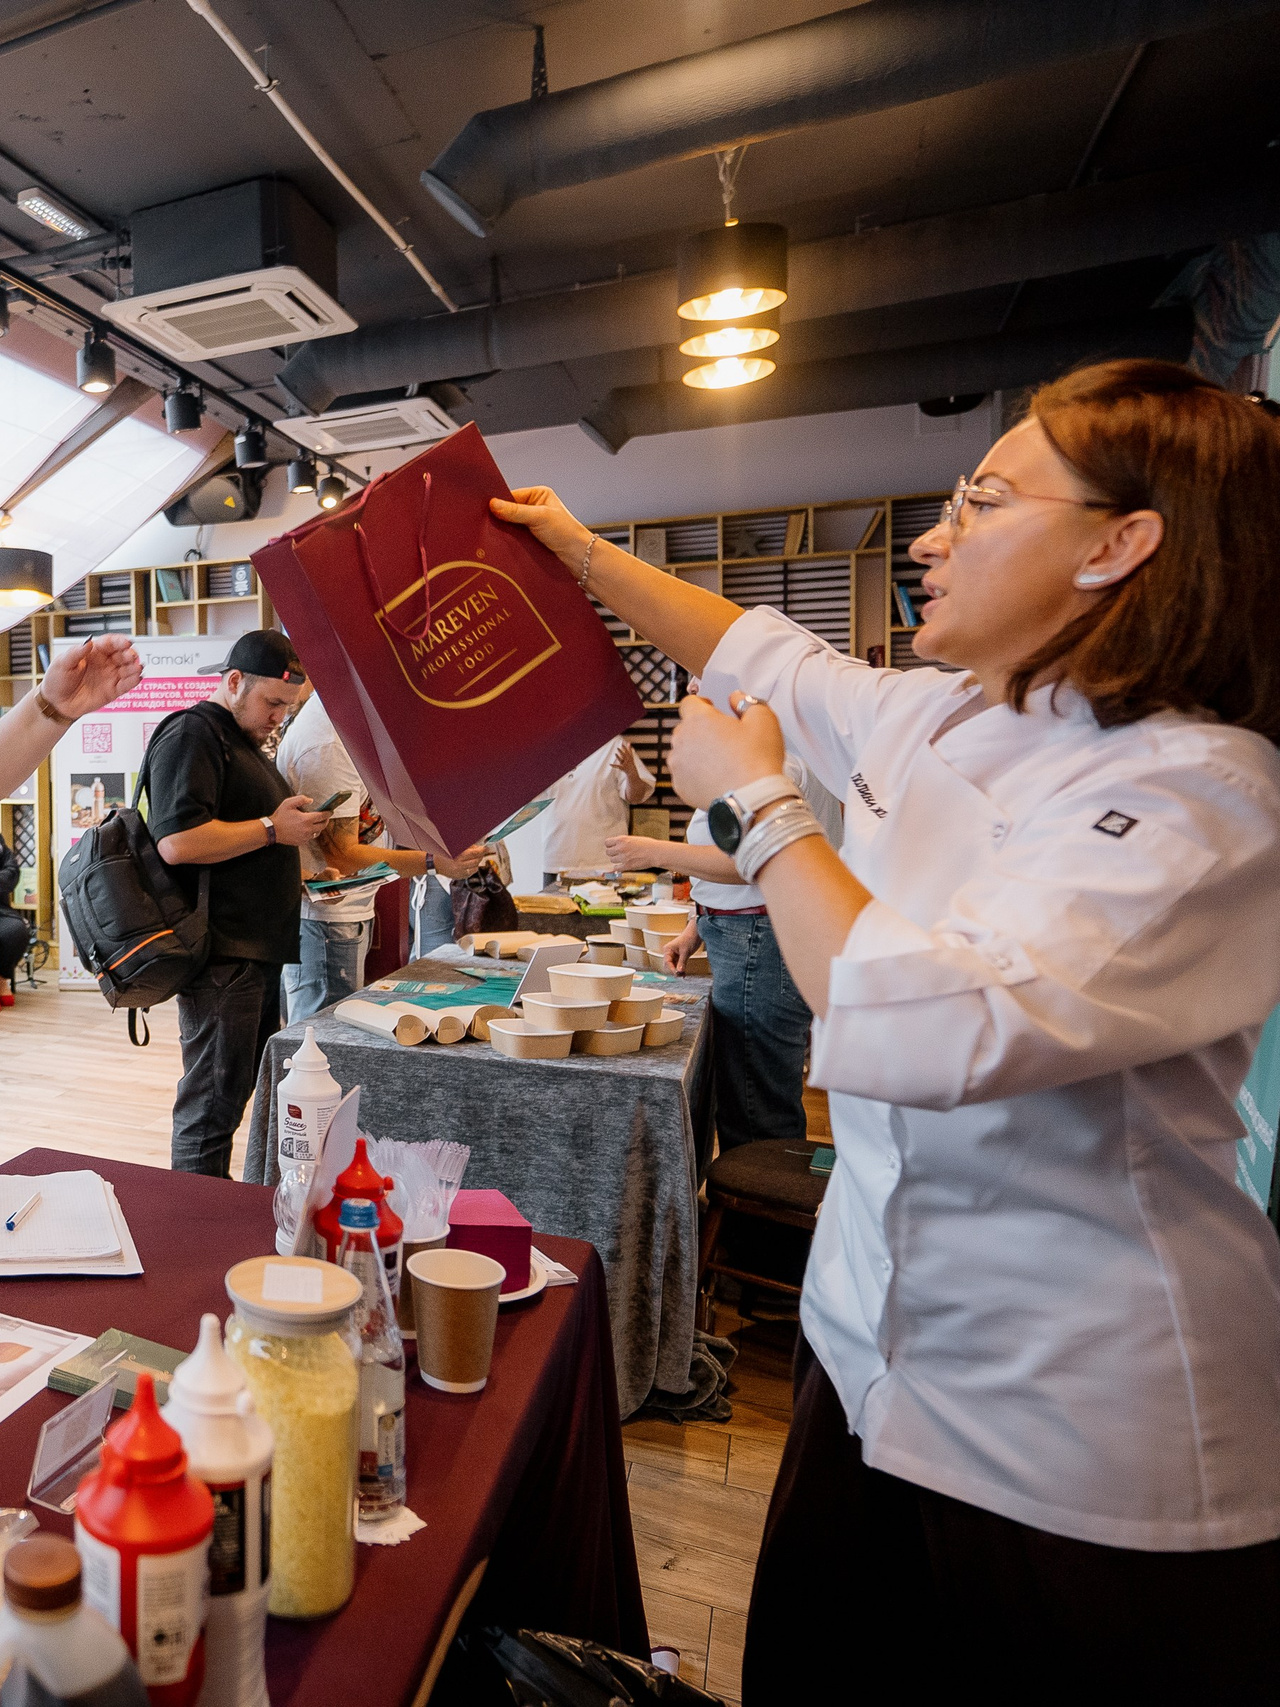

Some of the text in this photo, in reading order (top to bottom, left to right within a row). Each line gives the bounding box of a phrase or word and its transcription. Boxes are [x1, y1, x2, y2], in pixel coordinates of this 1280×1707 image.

[410, 584, 499, 662] MAREVEN
[421, 608, 512, 679] PROFESSIONAL
[457, 642, 494, 675] FOOD
[144, 682, 176, 690] СТРАСТЬ
[150, 691, 183, 700] ВКУСОВ,
[132, 700, 166, 710] КАЖДОЕ
[851, 772, 877, 807] ПОЛИНА
[284, 1117, 307, 1130] Sauce
